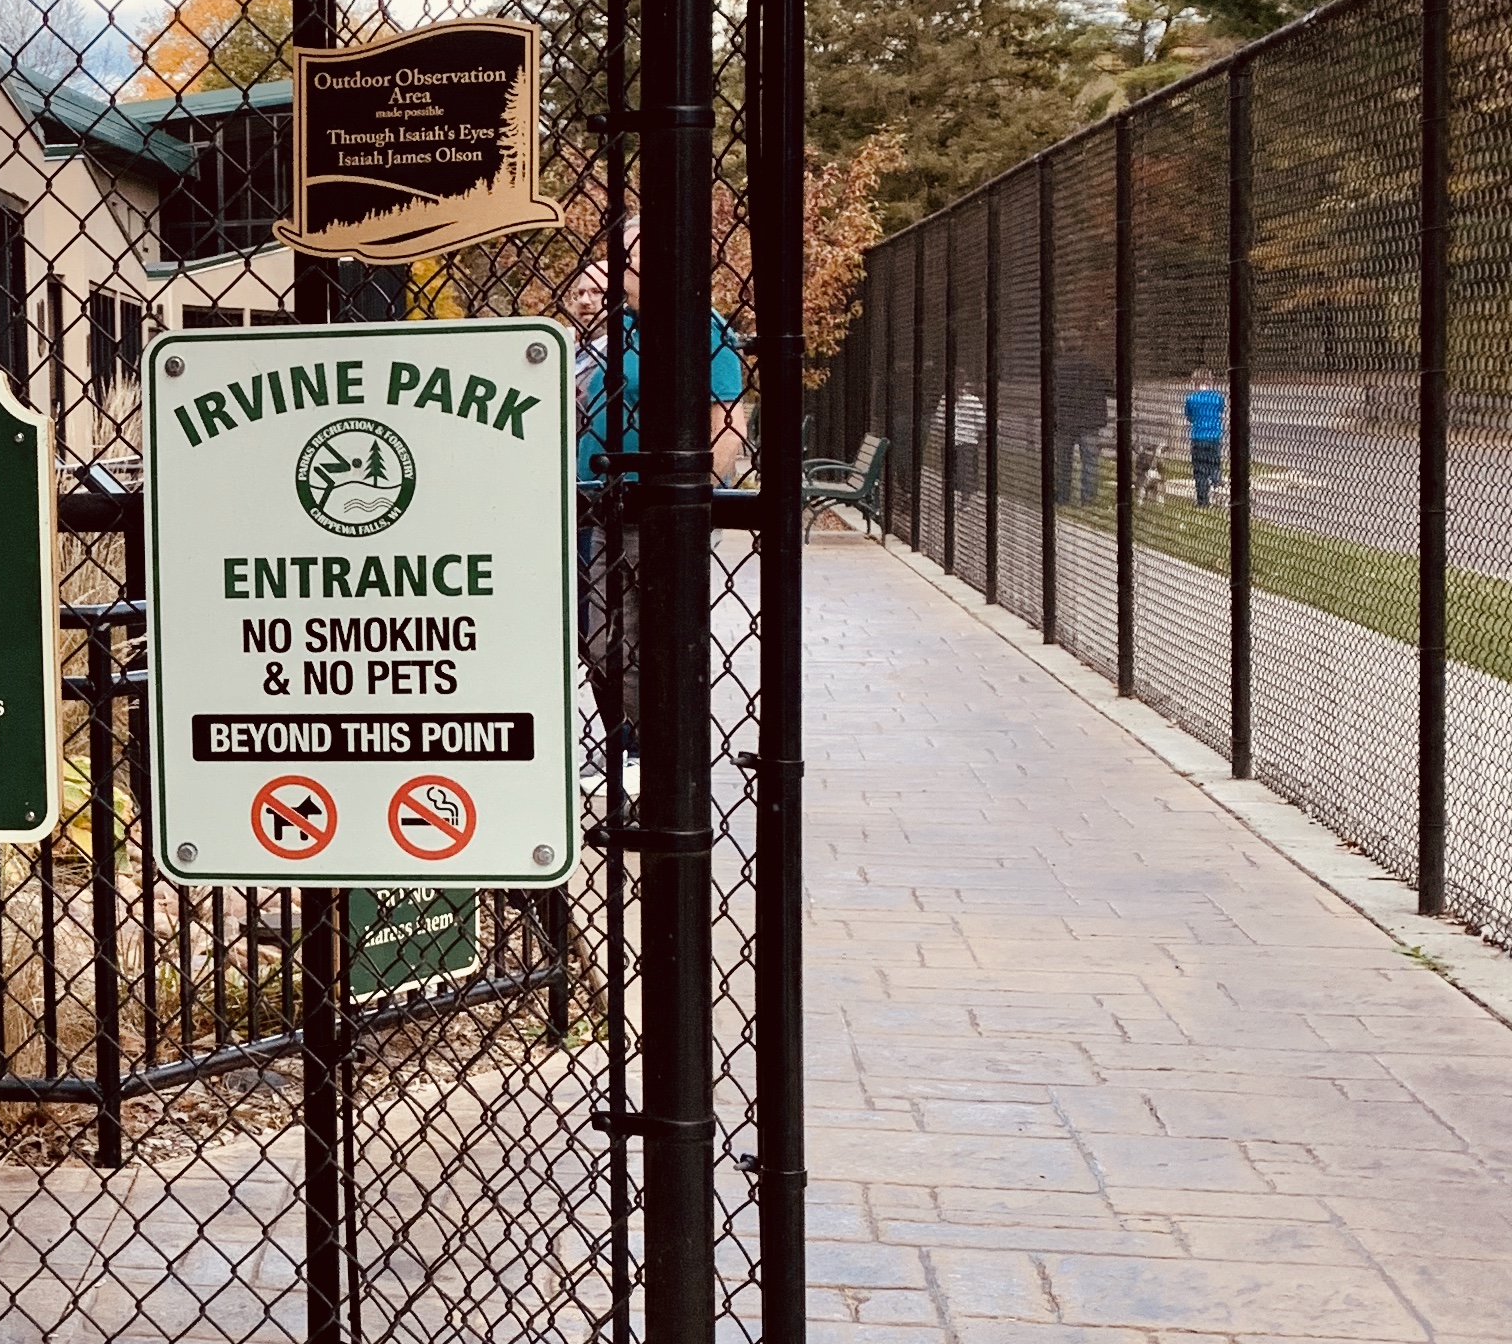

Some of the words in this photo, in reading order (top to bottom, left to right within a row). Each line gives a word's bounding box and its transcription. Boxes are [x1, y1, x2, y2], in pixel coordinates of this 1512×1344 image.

[314, 70, 392, 90] Outdoor
[395, 66, 507, 86] Observation
[388, 86, 432, 105] Area
[375, 107, 403, 118] made
[404, 106, 445, 121] possible
[326, 127, 395, 148] Through
[398, 124, 455, 142] Isaiah's
[459, 124, 495, 142] Eyes
[338, 150, 384, 167] Isaiah
[385, 149, 432, 169] James
[435, 147, 483, 163] Olson
[173, 359, 366, 448] IRVINE
[385, 360, 542, 441] PARK
[297, 447, 316, 481] PARKS
[312, 420, 375, 447] RECREATION
[375, 426, 384, 435] &
[383, 431, 414, 480] FORESTRY
[310, 507, 356, 535] CHIPPEWA
[388, 506, 402, 519] WI
[223, 553, 494, 599] ENTRANCE
[242, 617, 292, 654] NO
[305, 615, 477, 654] SMOKING
[262, 661, 291, 696] &
[303, 660, 354, 696] NO
[367, 659, 458, 695] PETS
[210, 722, 332, 753] BEYOND
[340, 721, 411, 753] THIS
[421, 721, 515, 753] POINT
